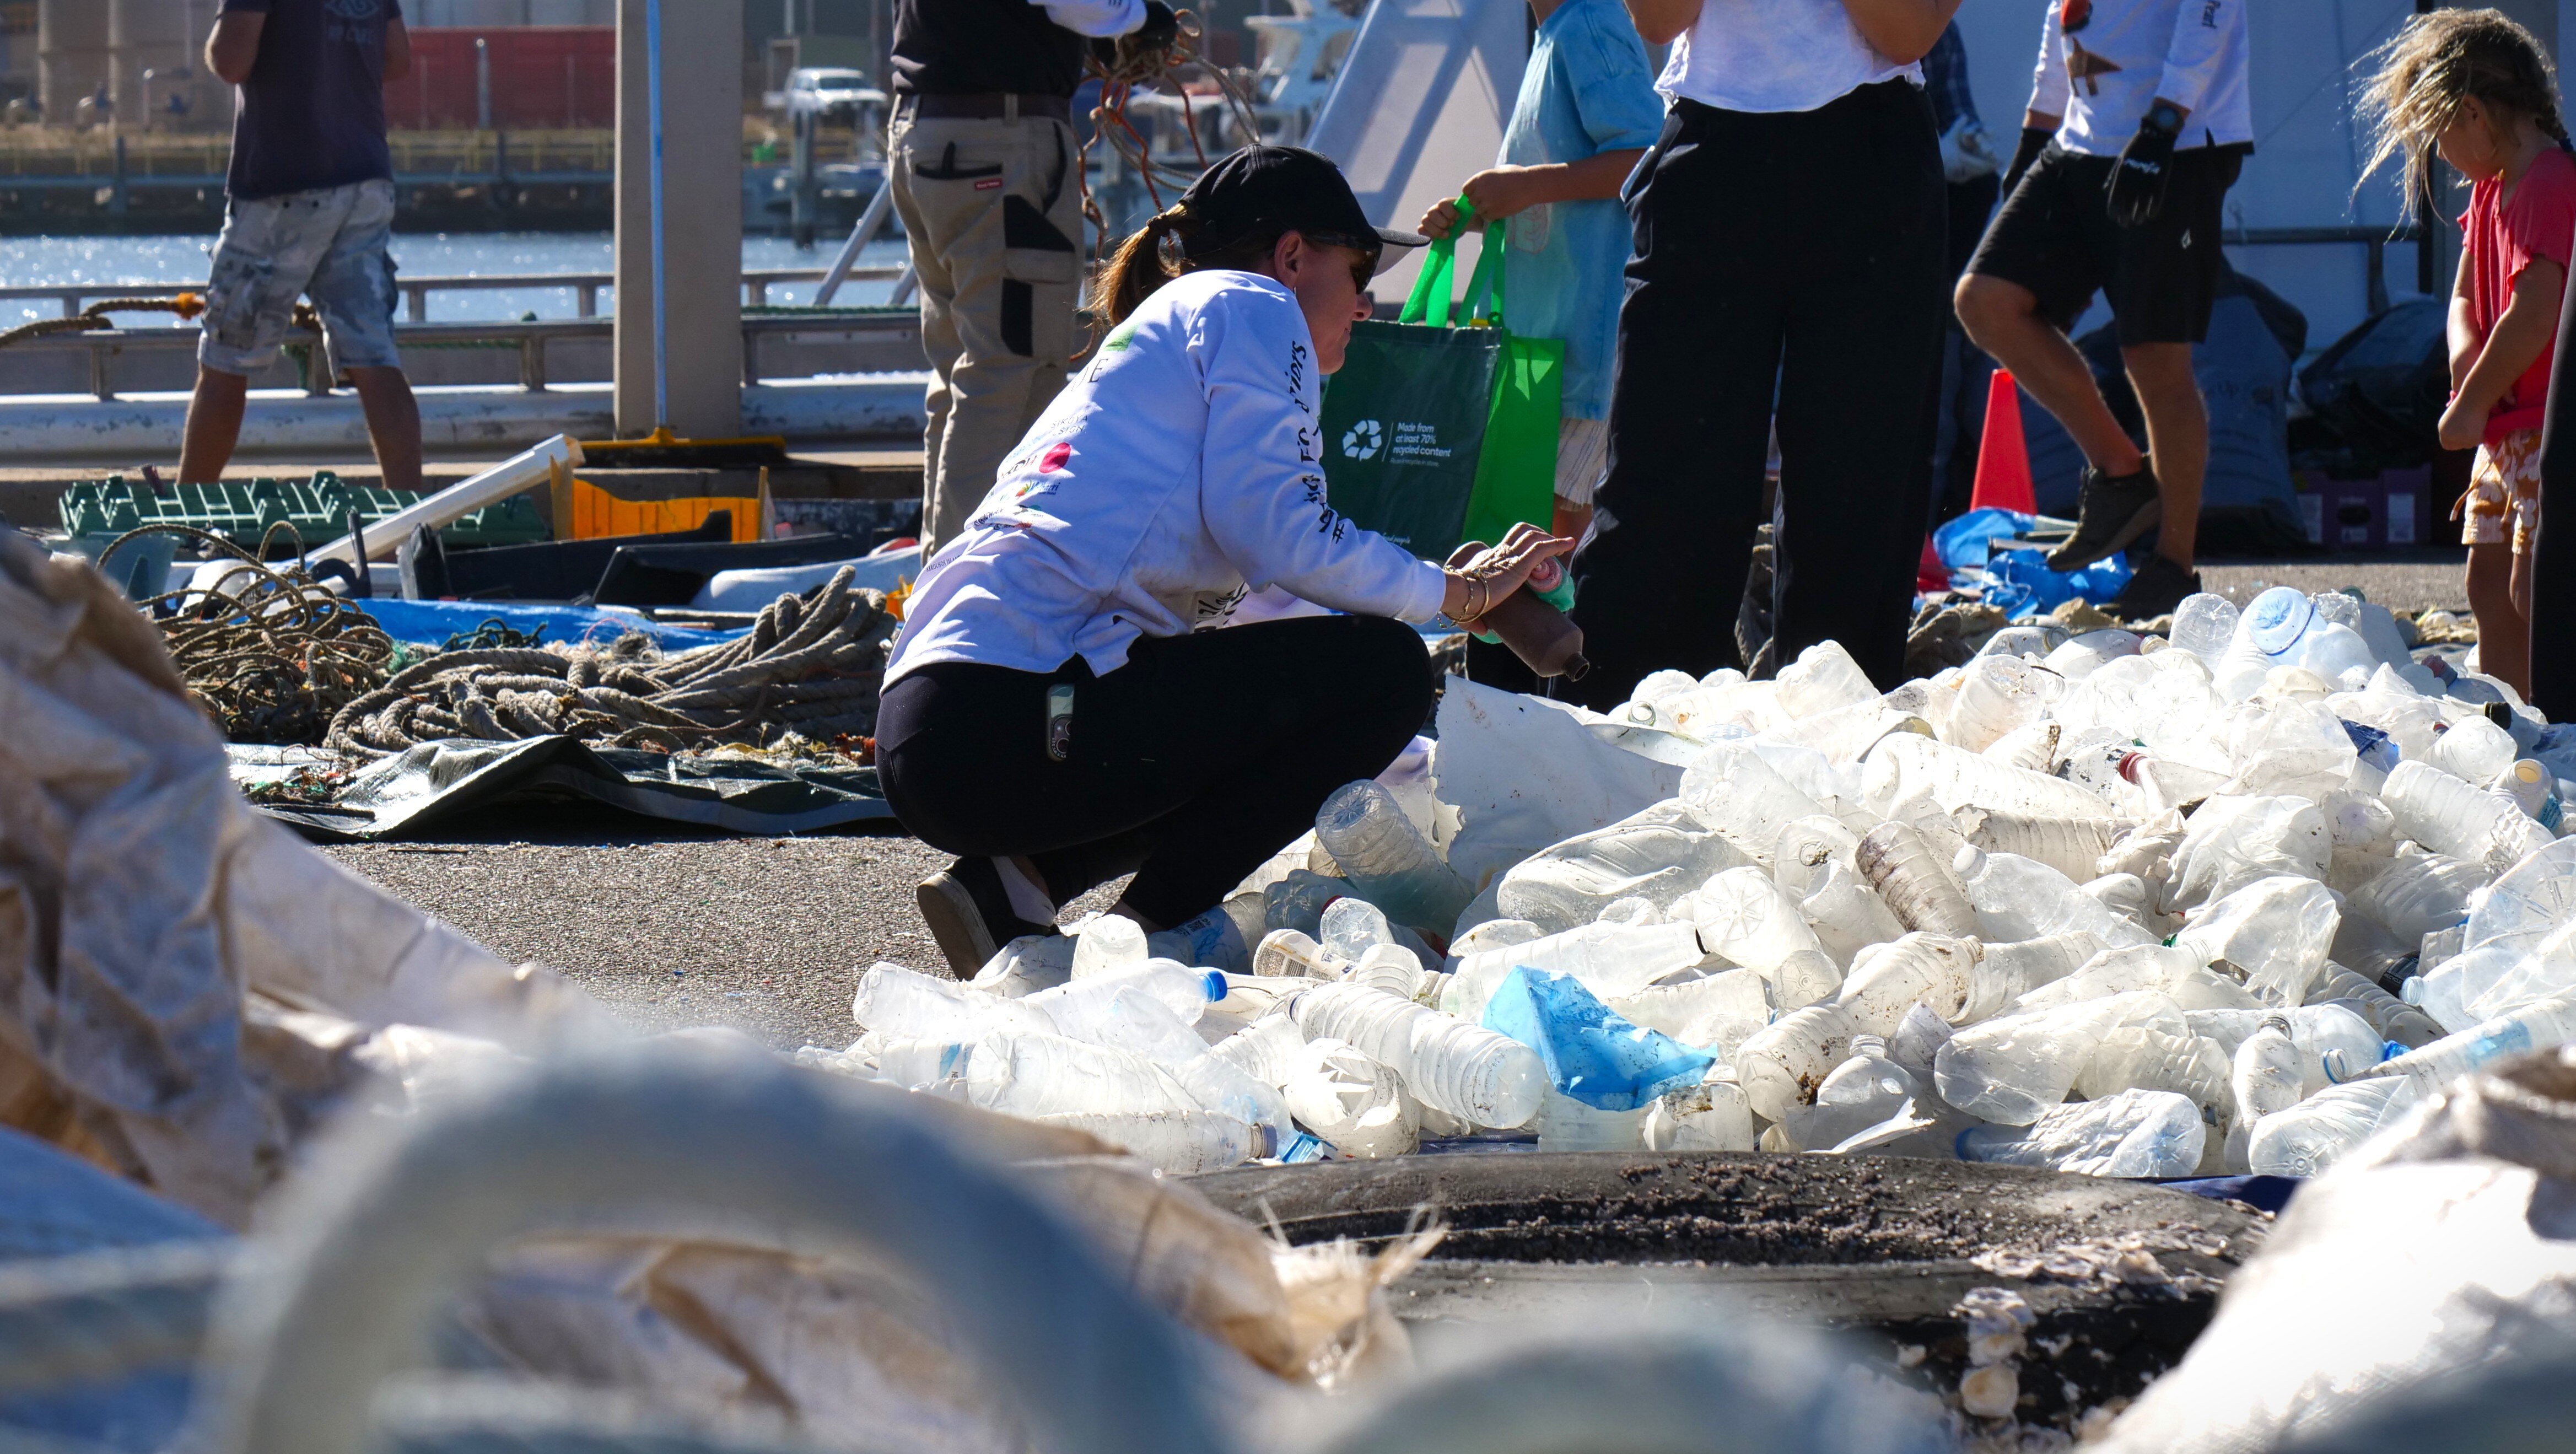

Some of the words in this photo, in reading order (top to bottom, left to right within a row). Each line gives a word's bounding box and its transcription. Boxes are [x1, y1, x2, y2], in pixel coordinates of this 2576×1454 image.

[1398, 422, 1416, 432] Made
[1417, 422, 1434, 433] from
[1395, 434, 1403, 443] at
[1403, 434, 1420, 443] least
[1420, 434, 1436, 444] 70%
[1393, 444, 1420, 456] recycled
[1420, 448, 1452, 457] content
